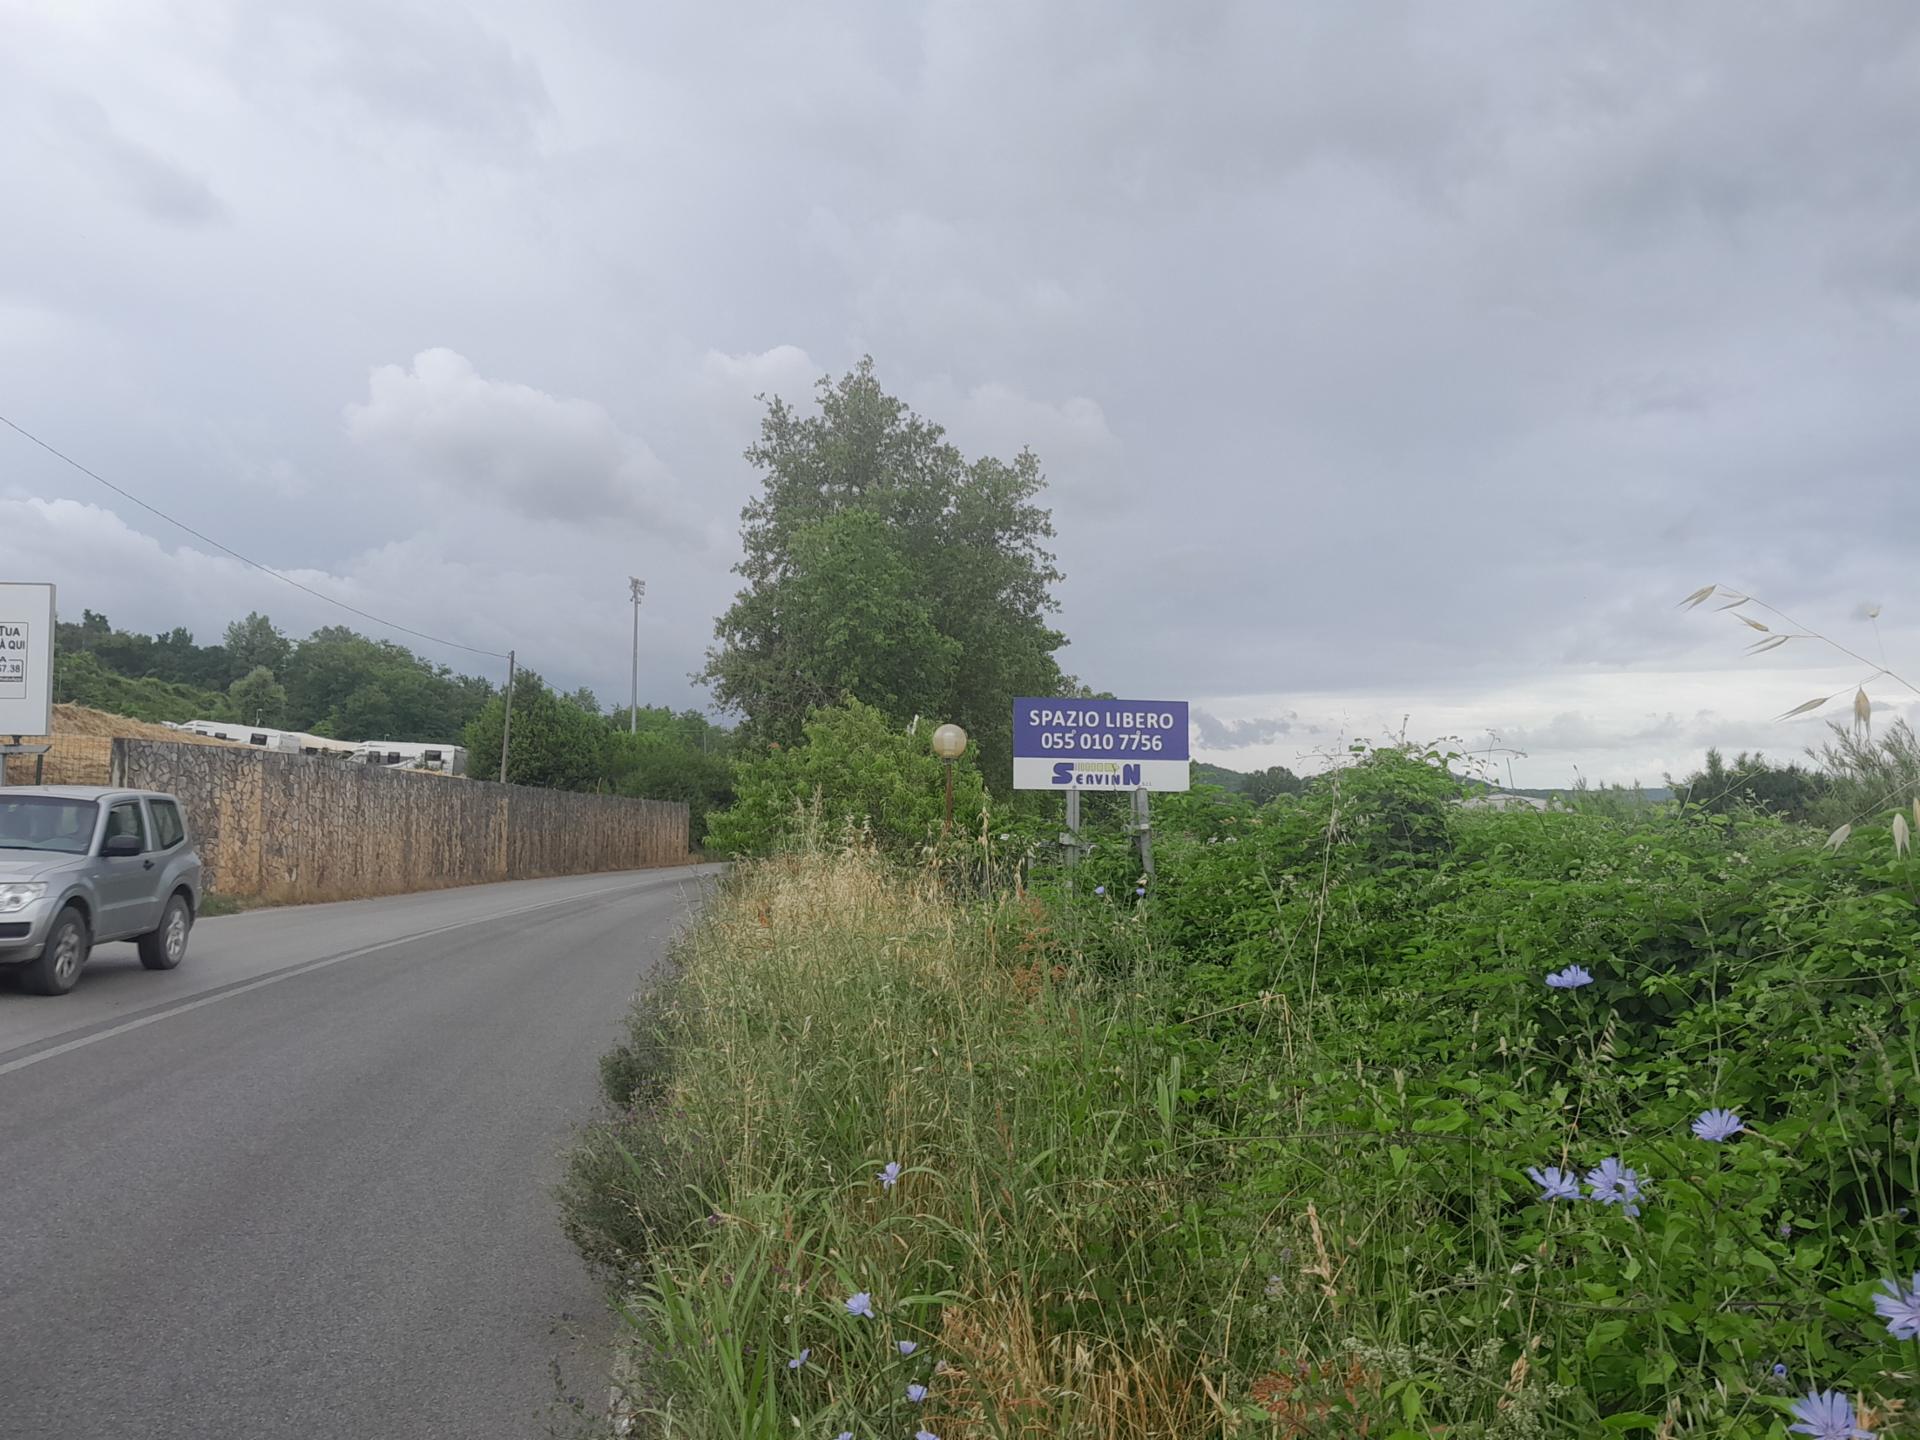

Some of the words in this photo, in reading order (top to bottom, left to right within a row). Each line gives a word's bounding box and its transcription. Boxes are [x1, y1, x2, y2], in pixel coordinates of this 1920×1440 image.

[8, 640, 25, 650] QUI
[1029, 710, 1099, 728] SPAZIO
[1106, 711, 1174, 729] LIBERO
[1041, 732, 1075, 749] 055
[1080, 733, 1113, 750] 010
[1119, 734, 1163, 751] 7756
